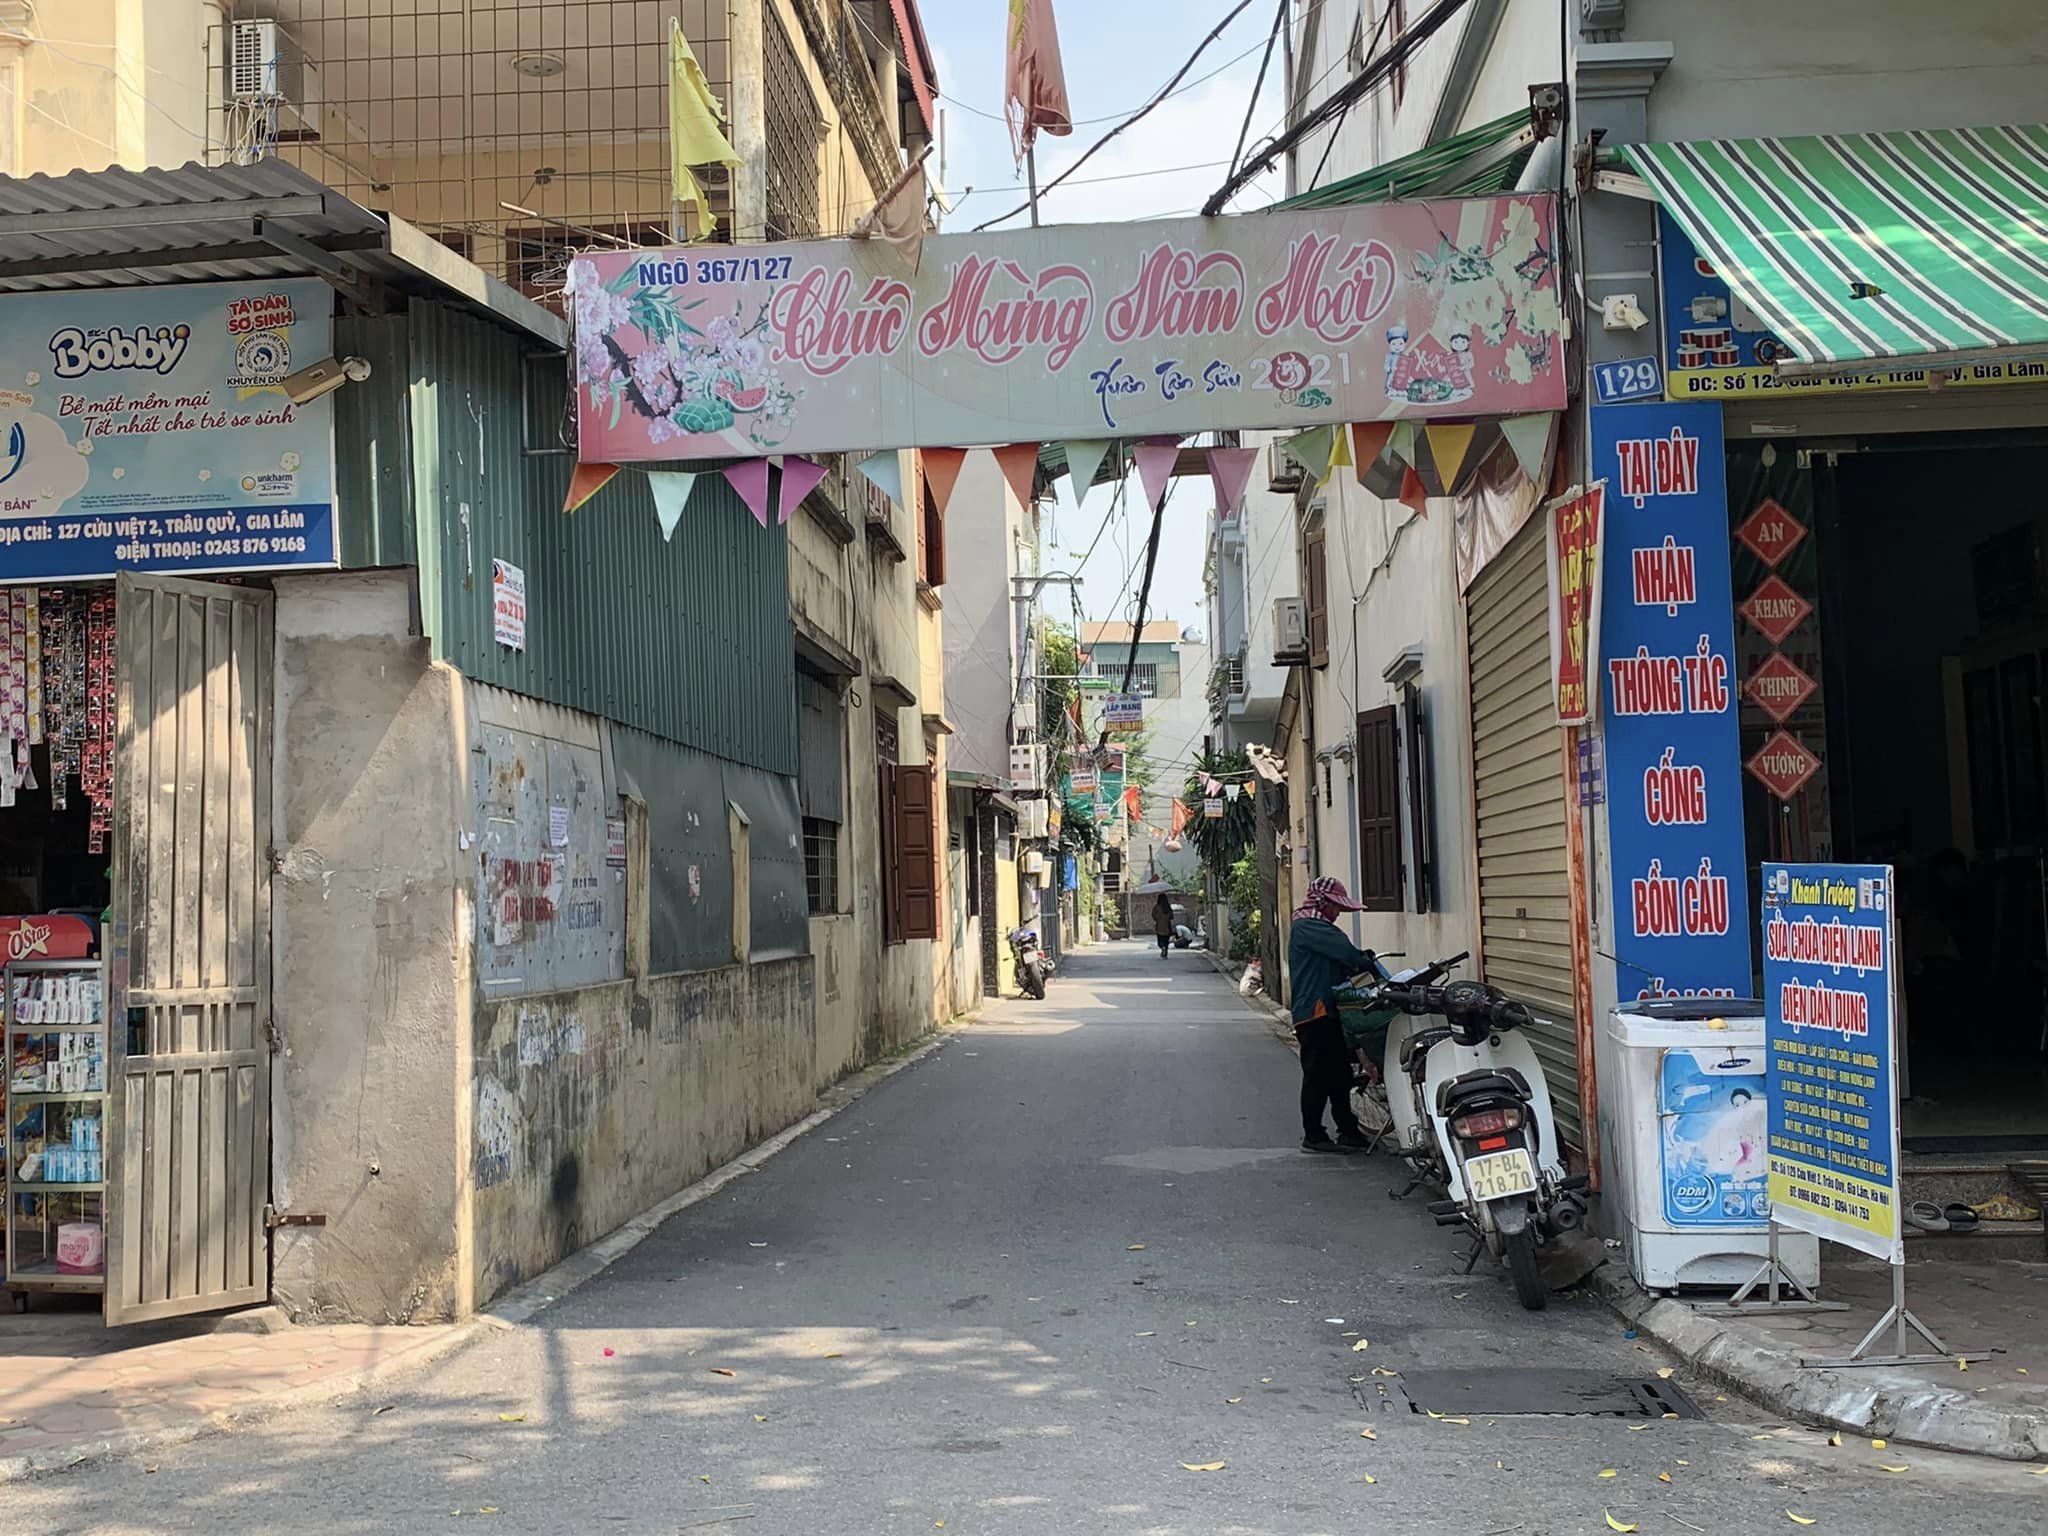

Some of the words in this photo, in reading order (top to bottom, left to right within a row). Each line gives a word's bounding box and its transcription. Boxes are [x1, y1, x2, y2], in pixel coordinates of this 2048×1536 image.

[639, 257, 689, 287] NGÕ
[695, 255, 793, 285] 367/127
[252, 294, 288, 311] DÁN
[769, 266, 912, 375] Chúc
[917, 252, 1094, 372] Mừng
[1105, 242, 1246, 344] Năm
[1253, 230, 1396, 345] Mới
[228, 317, 252, 333] SƠ
[253, 309, 294, 329] SINH
[50, 325, 191, 379] Bobby
[1602, 362, 1656, 398] 129
[1688, 376, 1718, 392] ĐC:
[1724, 371, 1747, 390] Số
[59, 393, 84, 418] Bề
[88, 394, 122, 417] mặt
[126, 390, 171, 412] mềm
[174, 389, 212, 410] mại
[84, 412, 114, 438] Tốt
[116, 410, 160, 436] nhất
[165, 413, 196, 433] cho
[199, 410, 228, 430] trẻ
[230, 413, 252, 429] sơ
[254, 404, 296, 427] sinh
[1616, 438, 1654, 509] TẠI
[1655, 426, 1699, 496] ĐÂY
[23, 519, 53, 542] CHỈ:
[58, 524, 81, 540] 127
[83, 517, 113, 538] CỬU
[115, 517, 147, 543] VIỆT
[149, 520, 163, 537] 2,
[165, 513, 204, 535] TRÂU
[206, 509, 241, 535] QUỲ,
[247, 514, 273, 531] GIA
[274, 509, 305, 530] LÂM
[1757, 522, 1785, 543] AN
[115, 540, 151, 564] ĐIỆN
[152, 540, 202, 561] THOẠI:
[204, 538, 240, 556] 0243
[242, 537, 266, 554] 876
[271, 536, 306, 553] 9168
[1632, 535, 1696, 617] NHẬN
[1754, 598, 1796, 619] KHANG
[1609, 645, 1684, 717] THÔNG
[1683, 634, 1729, 715] TẮC
[1757, 676, 1800, 702] THỊNH
[1761, 750, 1805, 779] VƯỢNG
[1644, 746, 1707, 825] CỐNG
[1632, 859, 1681, 937] BỒN
[1682, 856, 1729, 936] CẦU
[1791, 877, 1821, 905] Khánh
[1823, 877, 1857, 913] Trường
[1768, 908, 1790, 962] SỬA
[1790, 914, 1820, 966] CHỮA
[1820, 915, 1850, 975] ĐIỆN
[1849, 925, 1883, 978] LẠNH
[1781, 976, 1809, 1034] ĐIỆN
[1809, 978, 1833, 1032] DÂN
[1833, 989, 1869, 1042] DỤNG
[1476, 1153, 1521, 1179] 17-B4
[1475, 1170, 1532, 1199] 218.70
[1677, 1186, 1707, 1198] DDM
